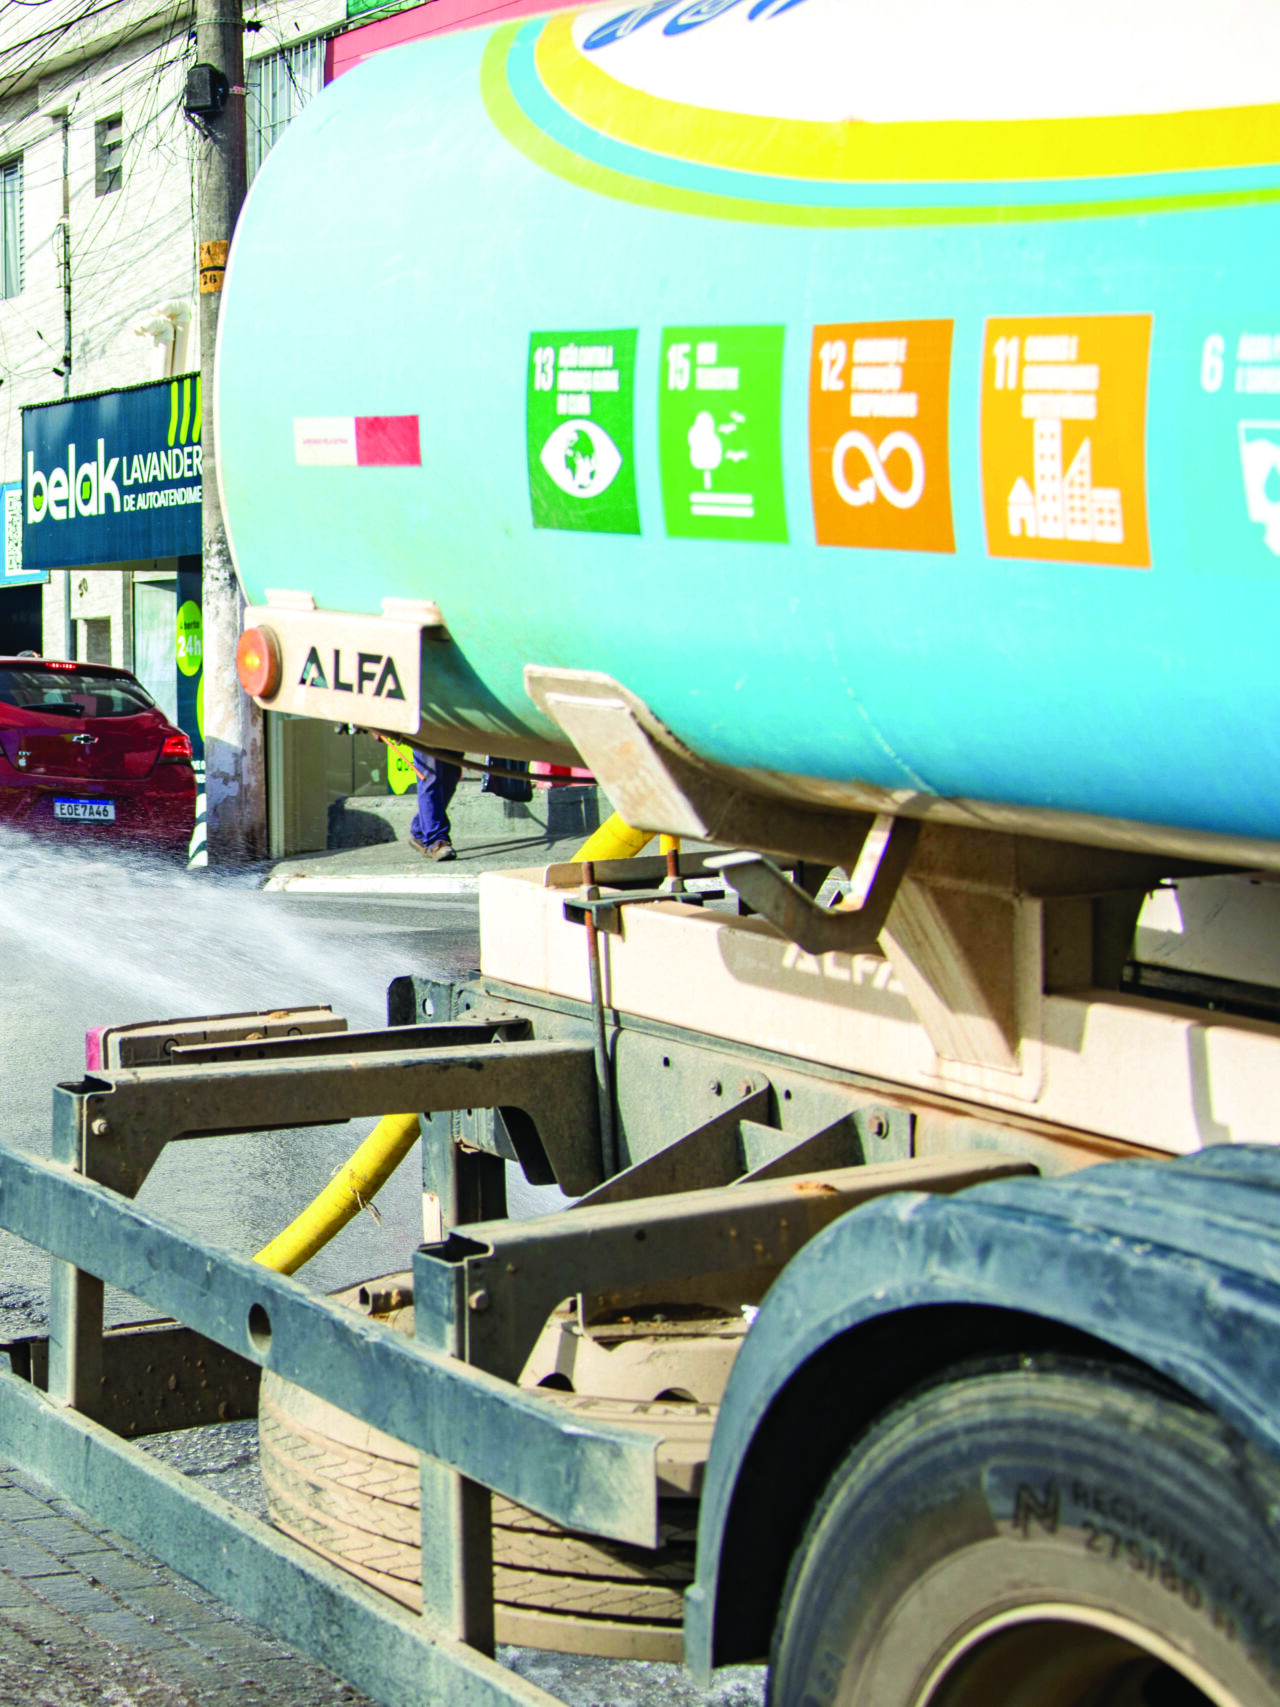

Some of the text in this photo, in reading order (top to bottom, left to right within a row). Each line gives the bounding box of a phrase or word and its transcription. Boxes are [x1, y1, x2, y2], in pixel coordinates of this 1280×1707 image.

[532, 346, 555, 391] 13
[667, 343, 691, 391] 15
[819, 339, 847, 392] 12
[993, 336, 1020, 391] 11
[1200, 333, 1225, 393] 6
[27, 438, 120, 524] belak
[124, 495, 135, 512] DE
[178, 634, 201, 657] 24h
[298, 646, 406, 701] ALFA
